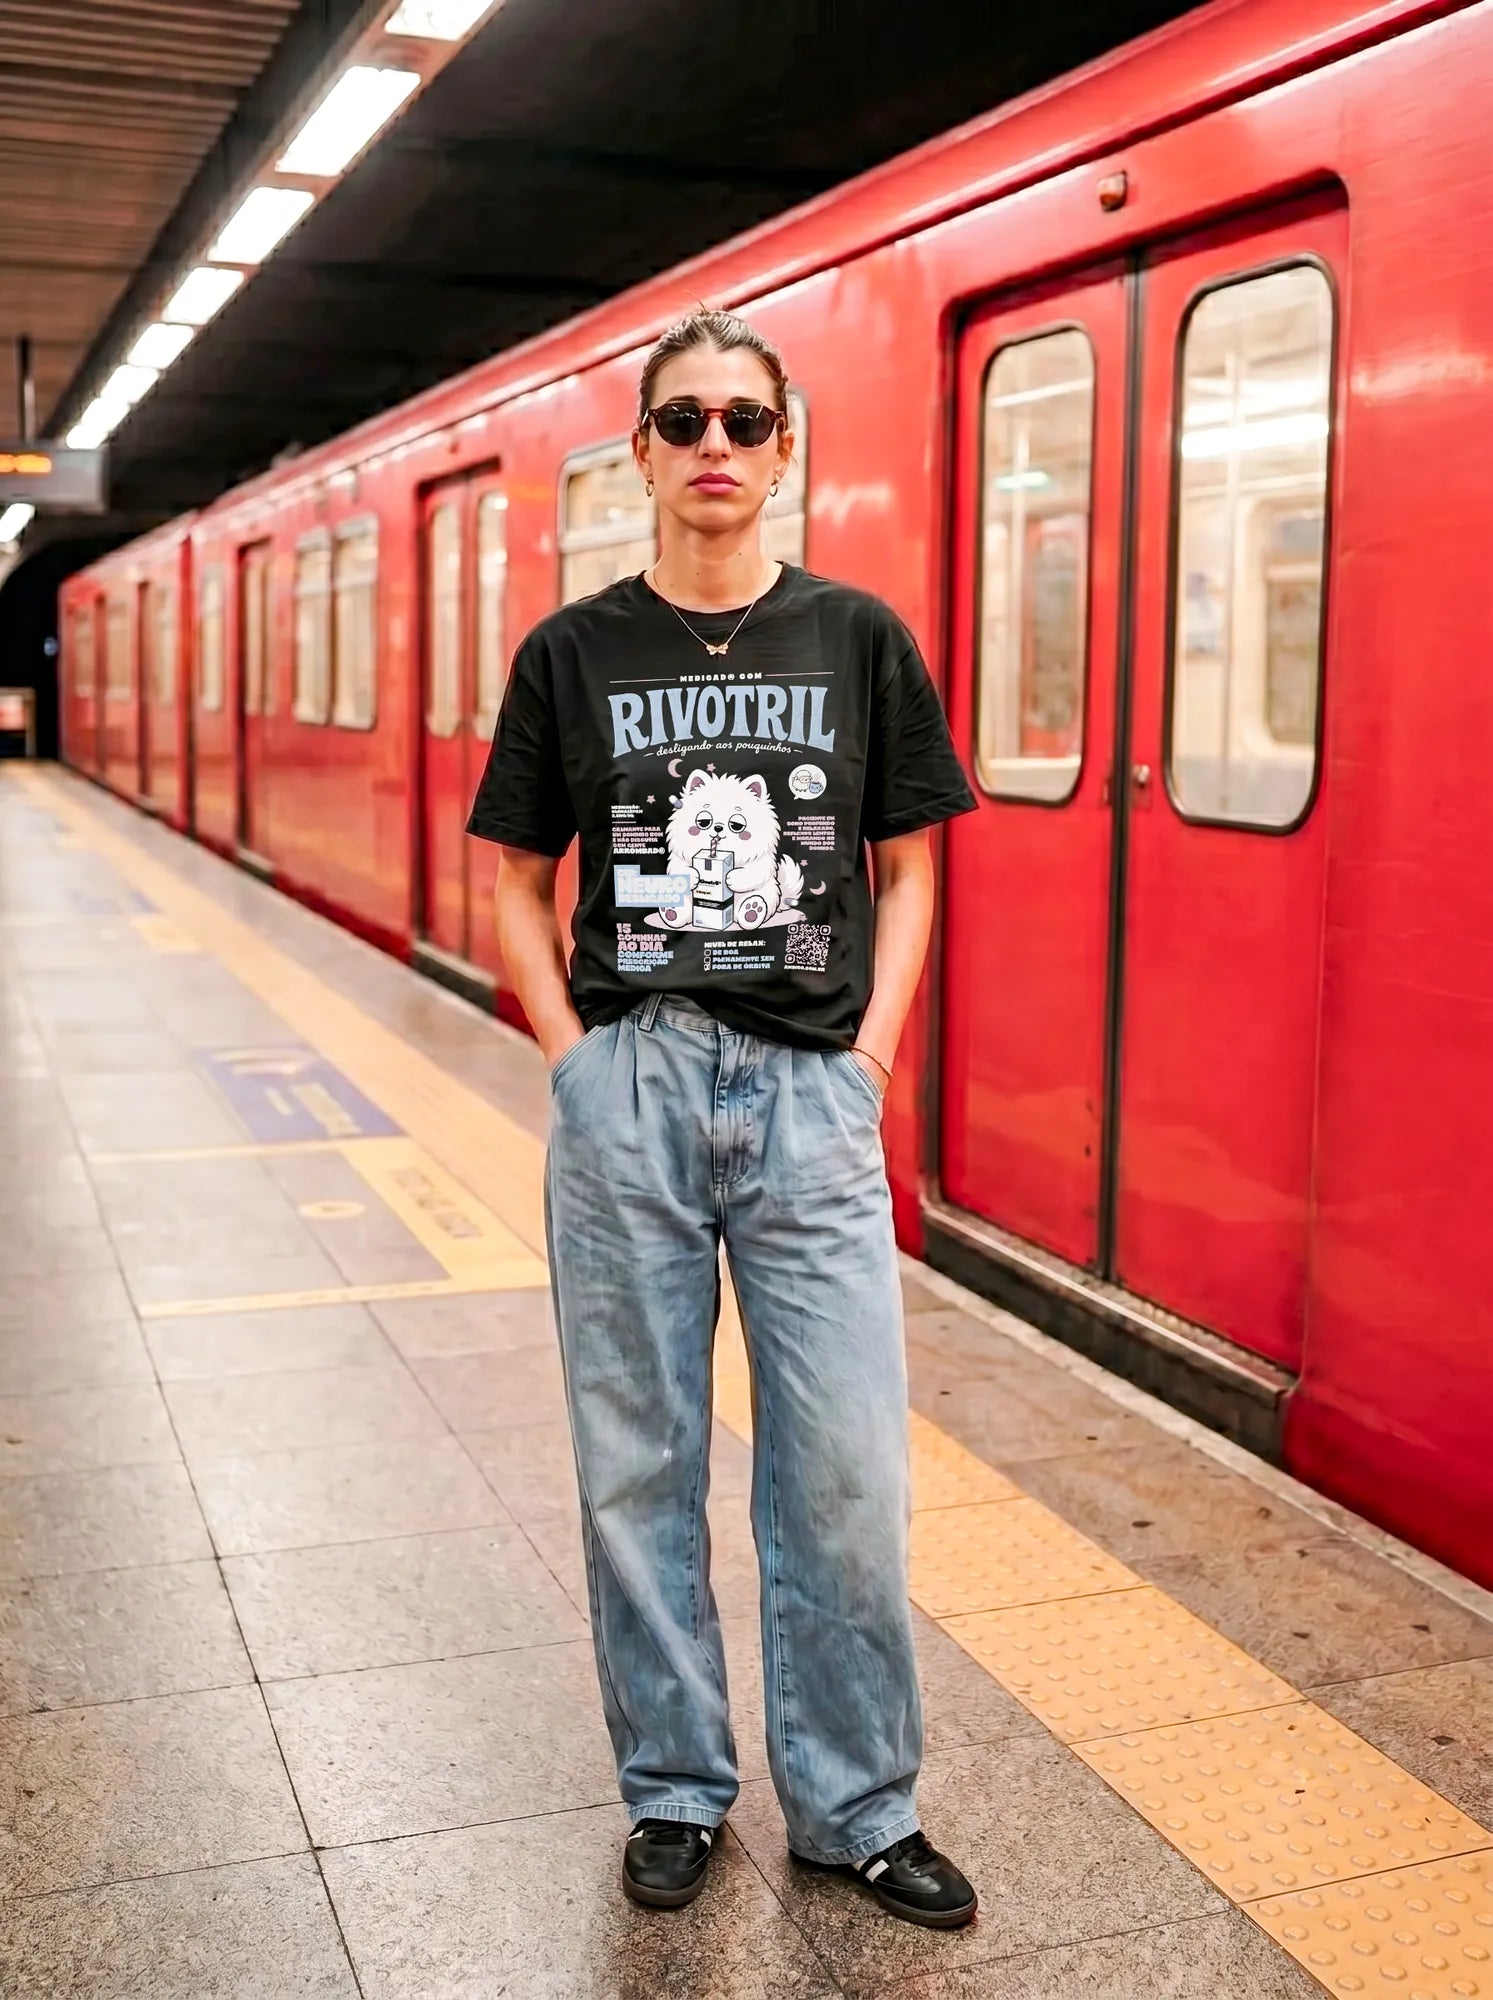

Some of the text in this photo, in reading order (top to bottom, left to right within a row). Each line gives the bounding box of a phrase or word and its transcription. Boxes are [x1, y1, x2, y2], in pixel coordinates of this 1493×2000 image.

[739, 672, 763, 680] COM
[607, 685, 836, 758] RIVOTRIL
[656, 739, 714, 756] desligando
[735, 742, 791, 754] pouquinhos
[618, 876, 688, 894] NEURO
[618, 893, 681, 904] DESLIGADO
[616, 922, 632, 934] 15
[617, 933, 668, 941] GOTINHAS
[617, 941, 664, 951] AO DIA
[617, 950, 674, 959] CONFORME
